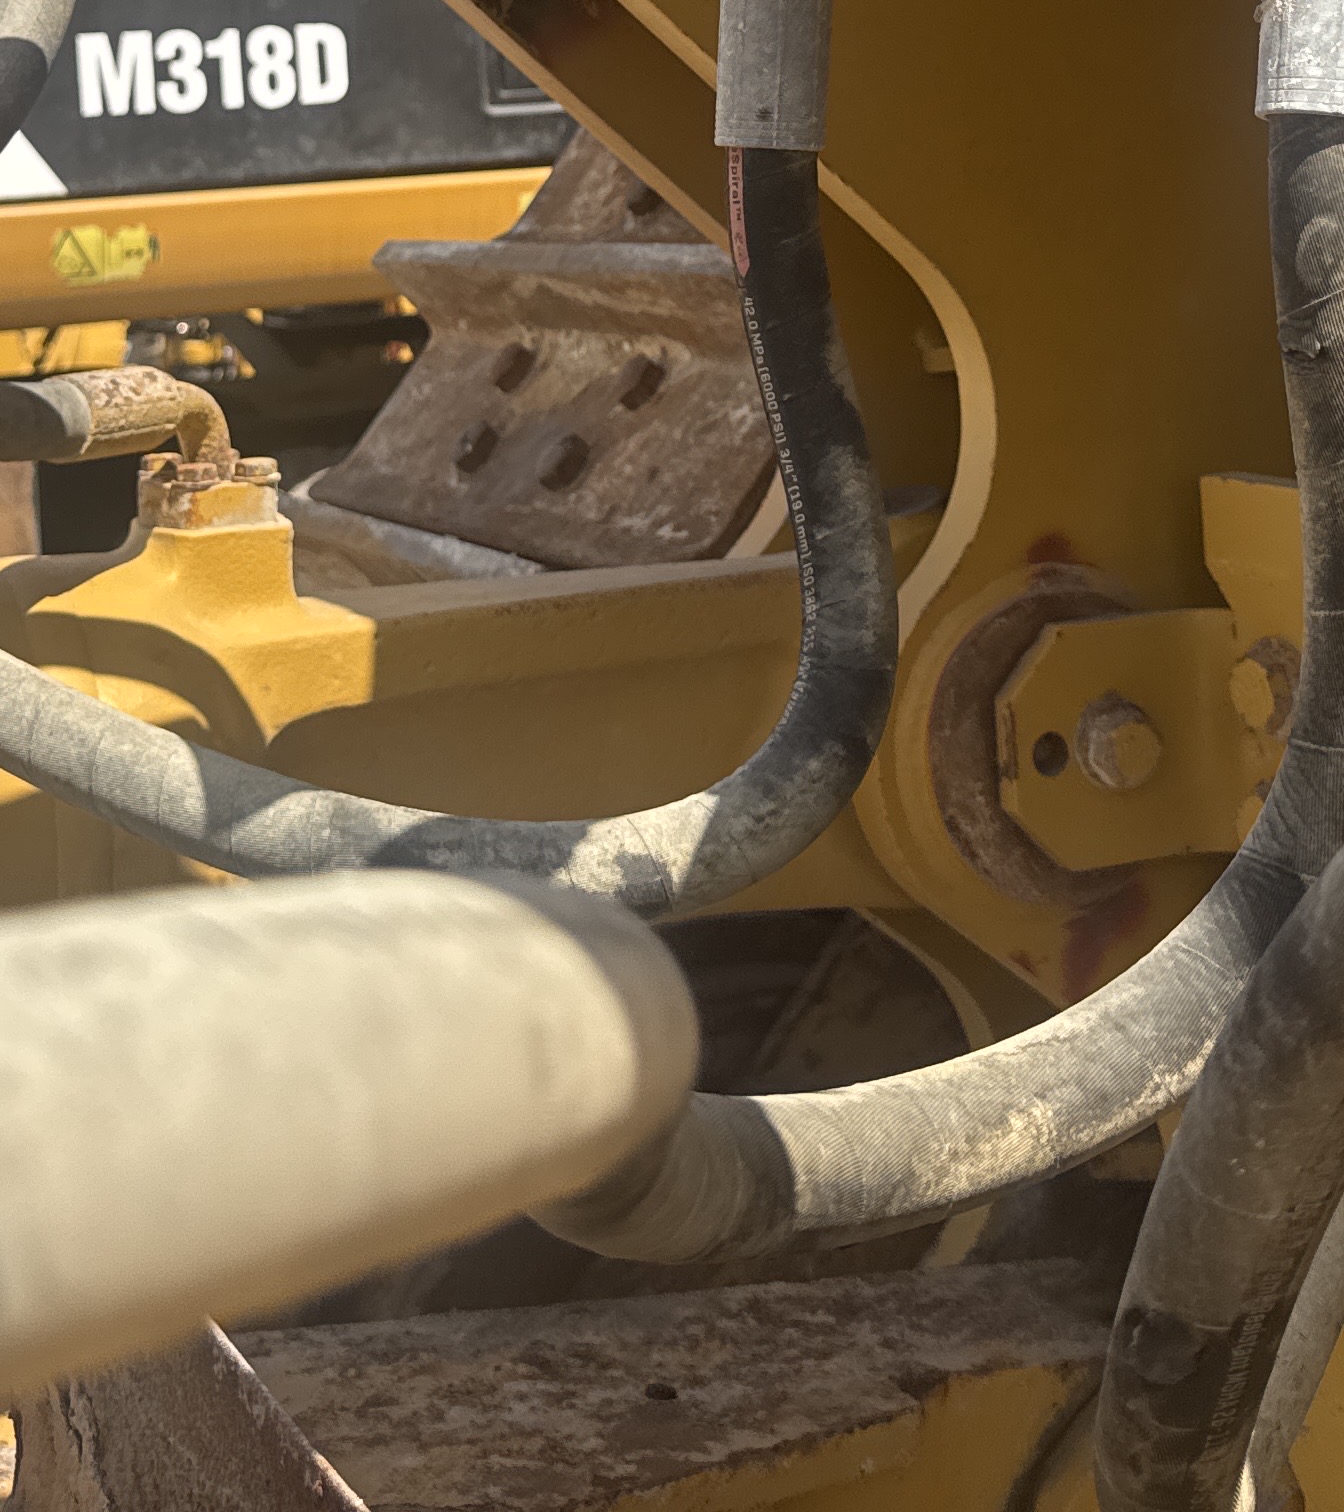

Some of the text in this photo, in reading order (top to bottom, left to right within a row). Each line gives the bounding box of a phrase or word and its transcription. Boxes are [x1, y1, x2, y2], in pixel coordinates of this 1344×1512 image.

[74, 22, 350, 117] M318D
[742, 295, 759, 330] 42.0
[750, 331, 767, 365] MPa
[757, 365, 779, 411] [6000
[769, 411, 787, 444] PSI]
[801, 562, 814, 586] ISO
